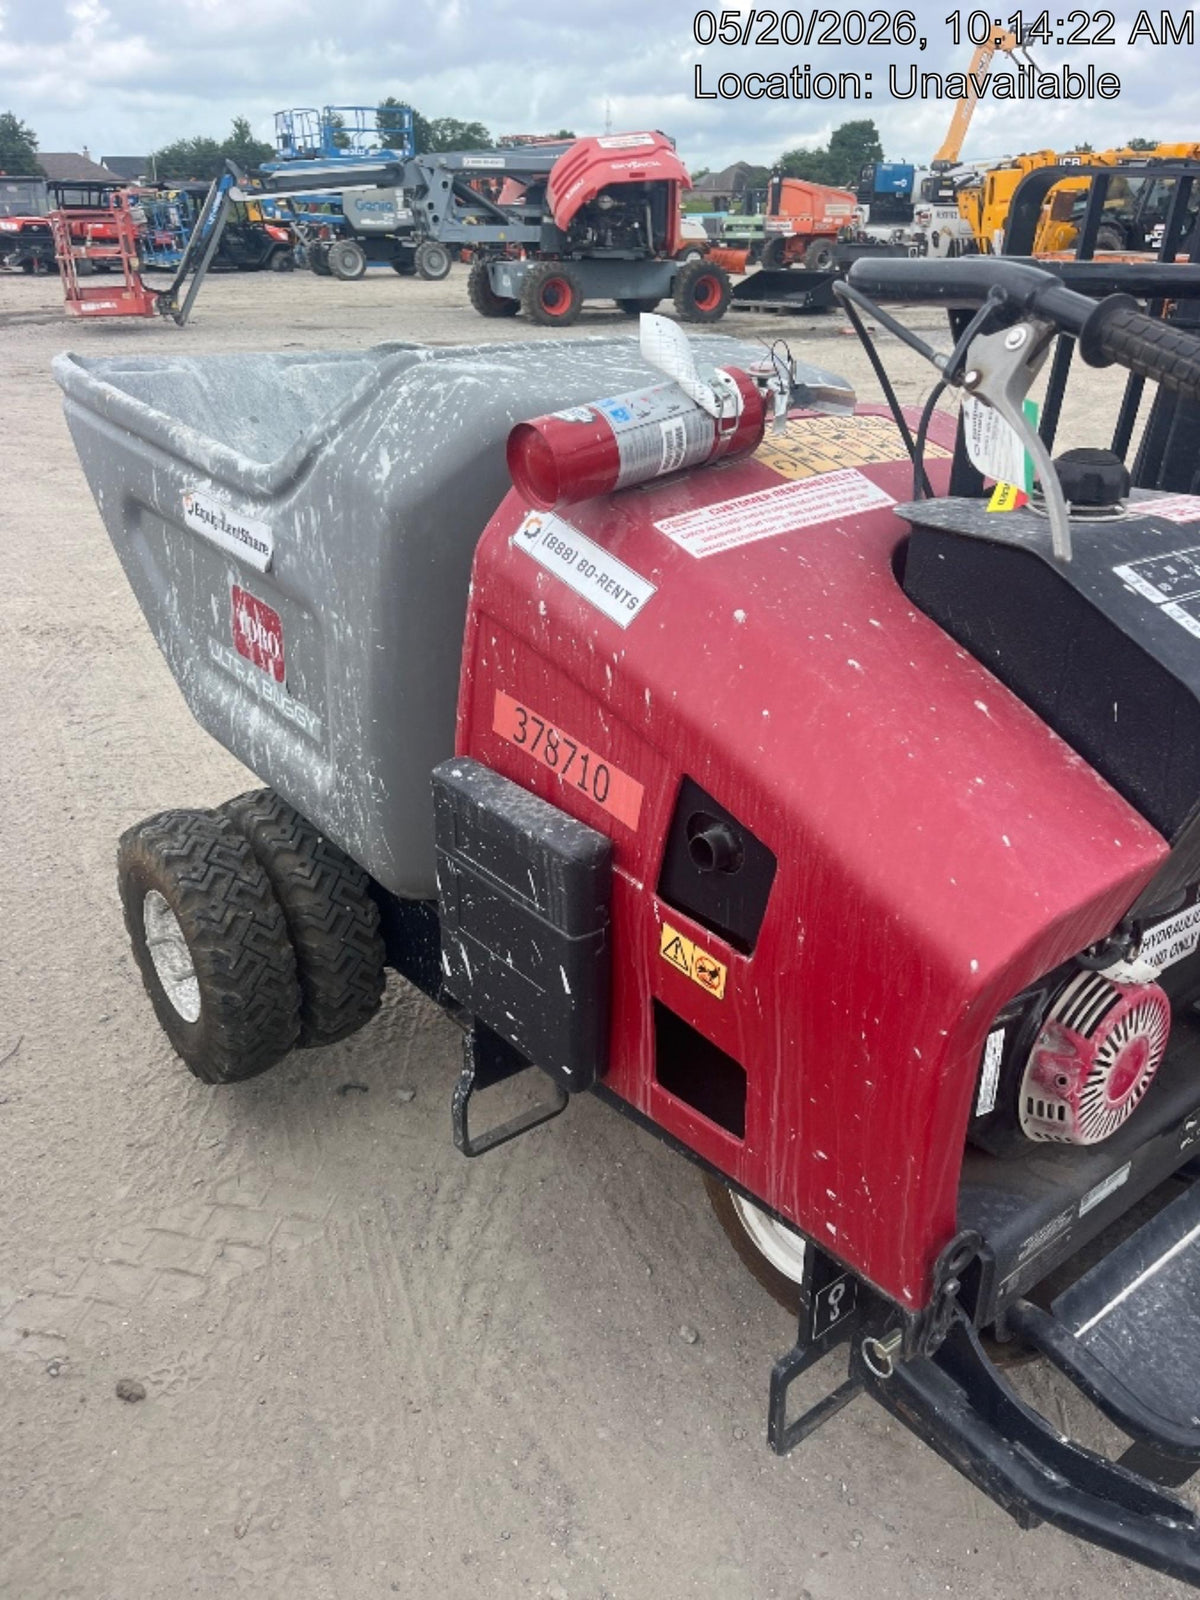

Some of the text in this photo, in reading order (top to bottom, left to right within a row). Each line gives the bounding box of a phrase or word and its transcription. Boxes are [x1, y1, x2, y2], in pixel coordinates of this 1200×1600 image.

[541, 532, 640, 611] (888) 80-RENTS
[513, 706, 610, 803] 378710
